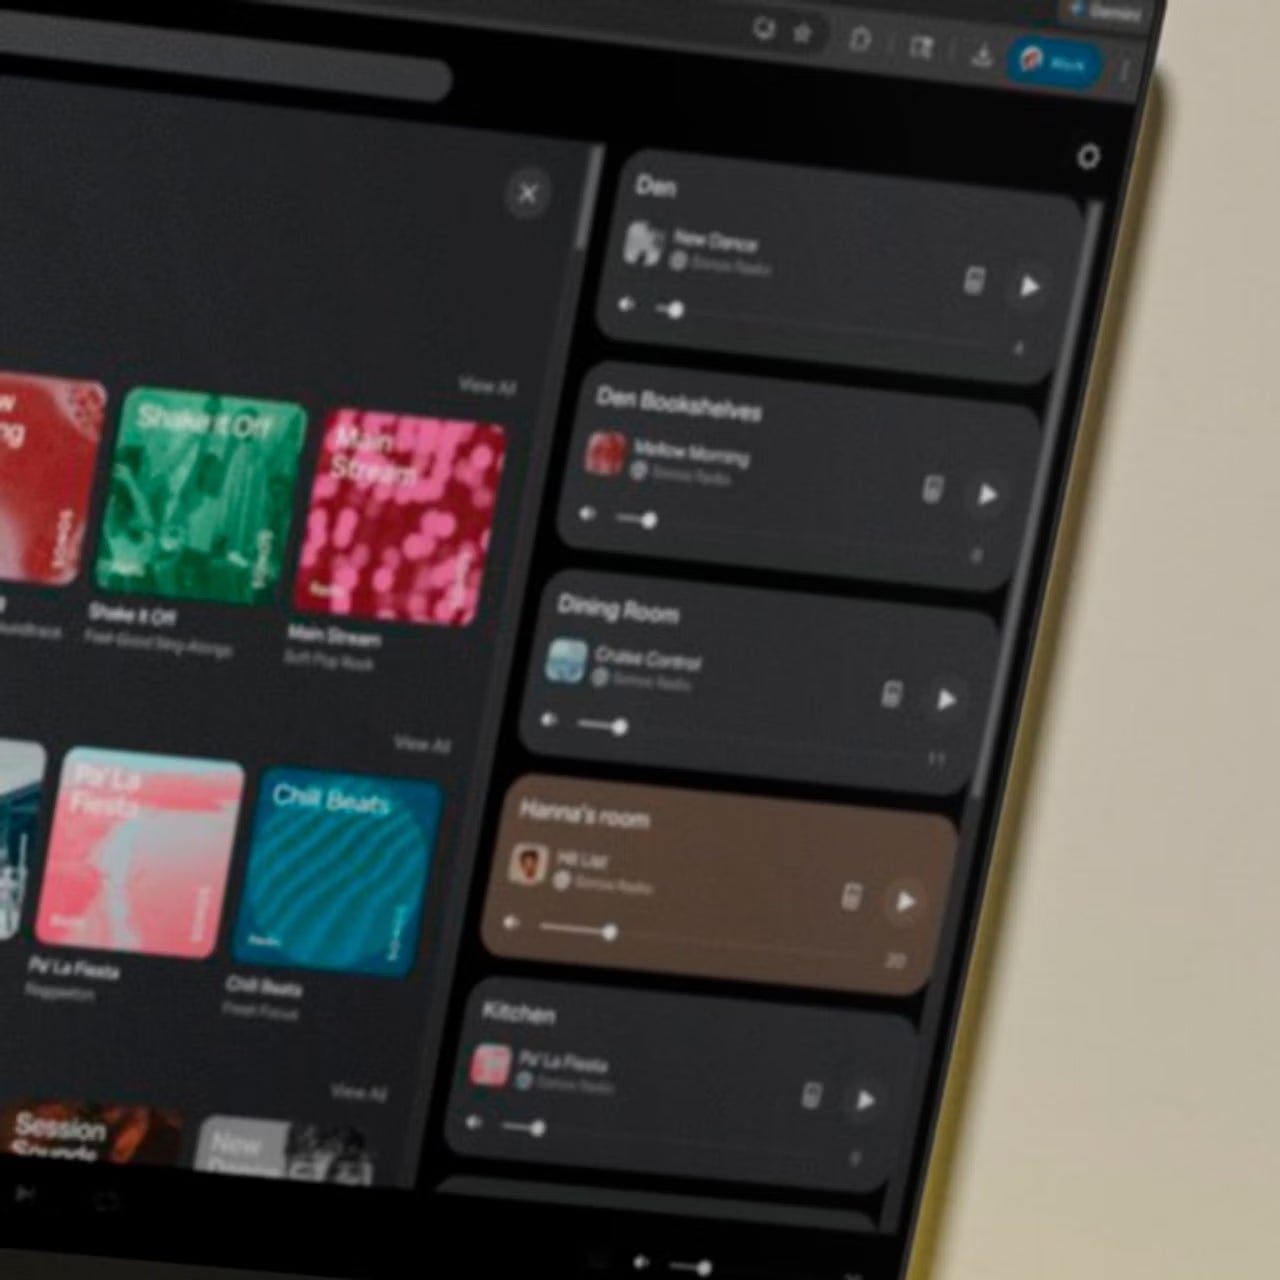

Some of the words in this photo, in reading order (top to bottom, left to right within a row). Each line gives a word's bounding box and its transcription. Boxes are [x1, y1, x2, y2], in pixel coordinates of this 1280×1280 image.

[636, 173, 678, 198] Den
[596, 384, 636, 408] Den
[640, 389, 763, 423] Bookshelves
[335, 424, 393, 452] Main
[558, 592, 621, 623] Dining
[623, 599, 680, 626] Room
[273, 782, 322, 807] Chill
[326, 789, 390, 816] Beats
[520, 797, 595, 825] Hanna's
[599, 809, 651, 831] room
[482, 1000, 557, 1027] Kitchen
[16, 1110, 107, 1143] Session
[212, 1131, 261, 1156] New
